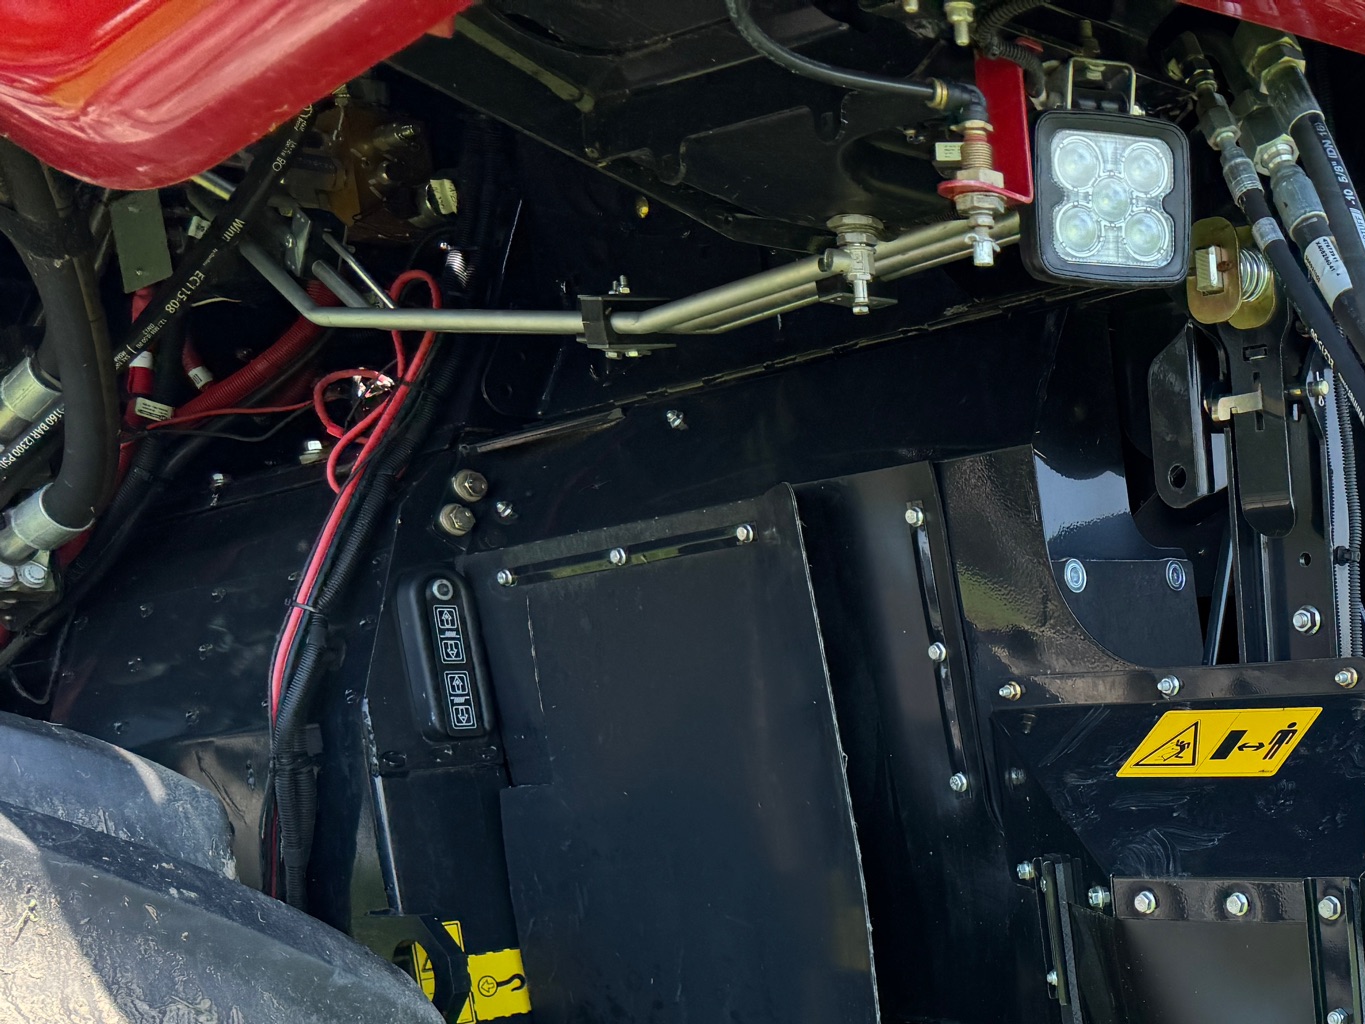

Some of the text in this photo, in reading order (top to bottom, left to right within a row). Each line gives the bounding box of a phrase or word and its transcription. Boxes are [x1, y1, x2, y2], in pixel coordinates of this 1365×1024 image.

[1341, 186, 1358, 206] -10
[165, 270, 206, 314] EC115-08
[33, 422, 49, 439] BAR
[12, 433, 35, 457] (2300
